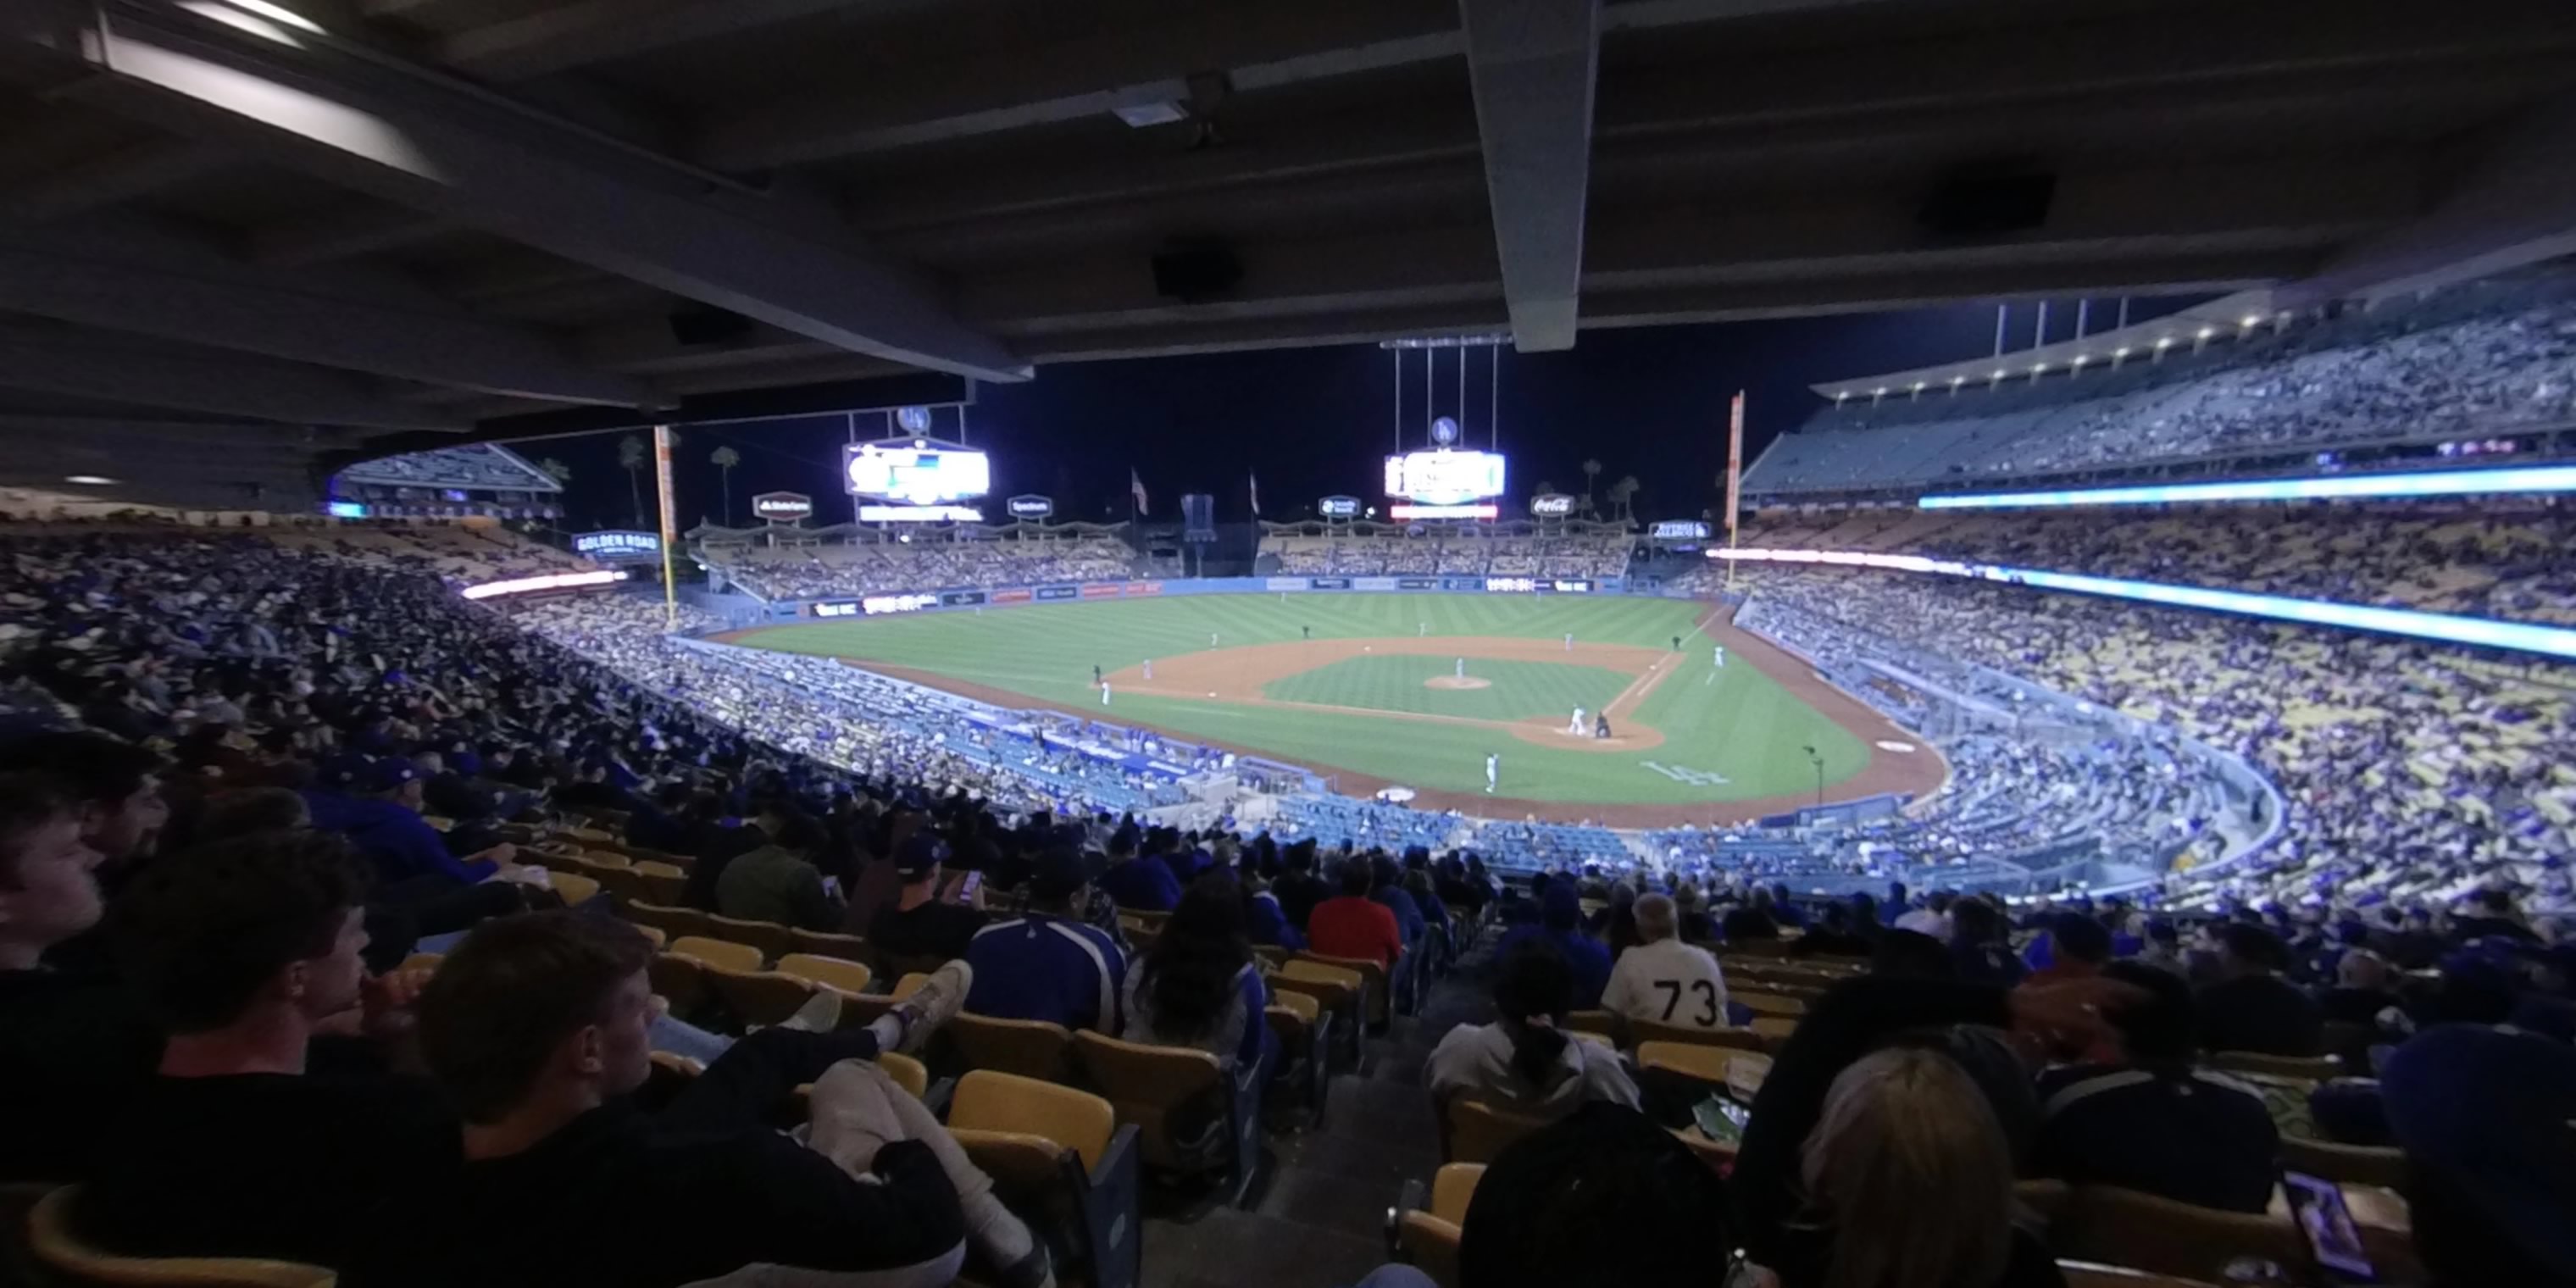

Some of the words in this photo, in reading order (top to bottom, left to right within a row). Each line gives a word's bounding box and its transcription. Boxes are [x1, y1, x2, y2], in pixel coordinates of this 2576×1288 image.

[577, 535, 625, 551] GOLDEN
[625, 535, 657, 550] ROAD
[1654, 980, 1717, 1027] 73
